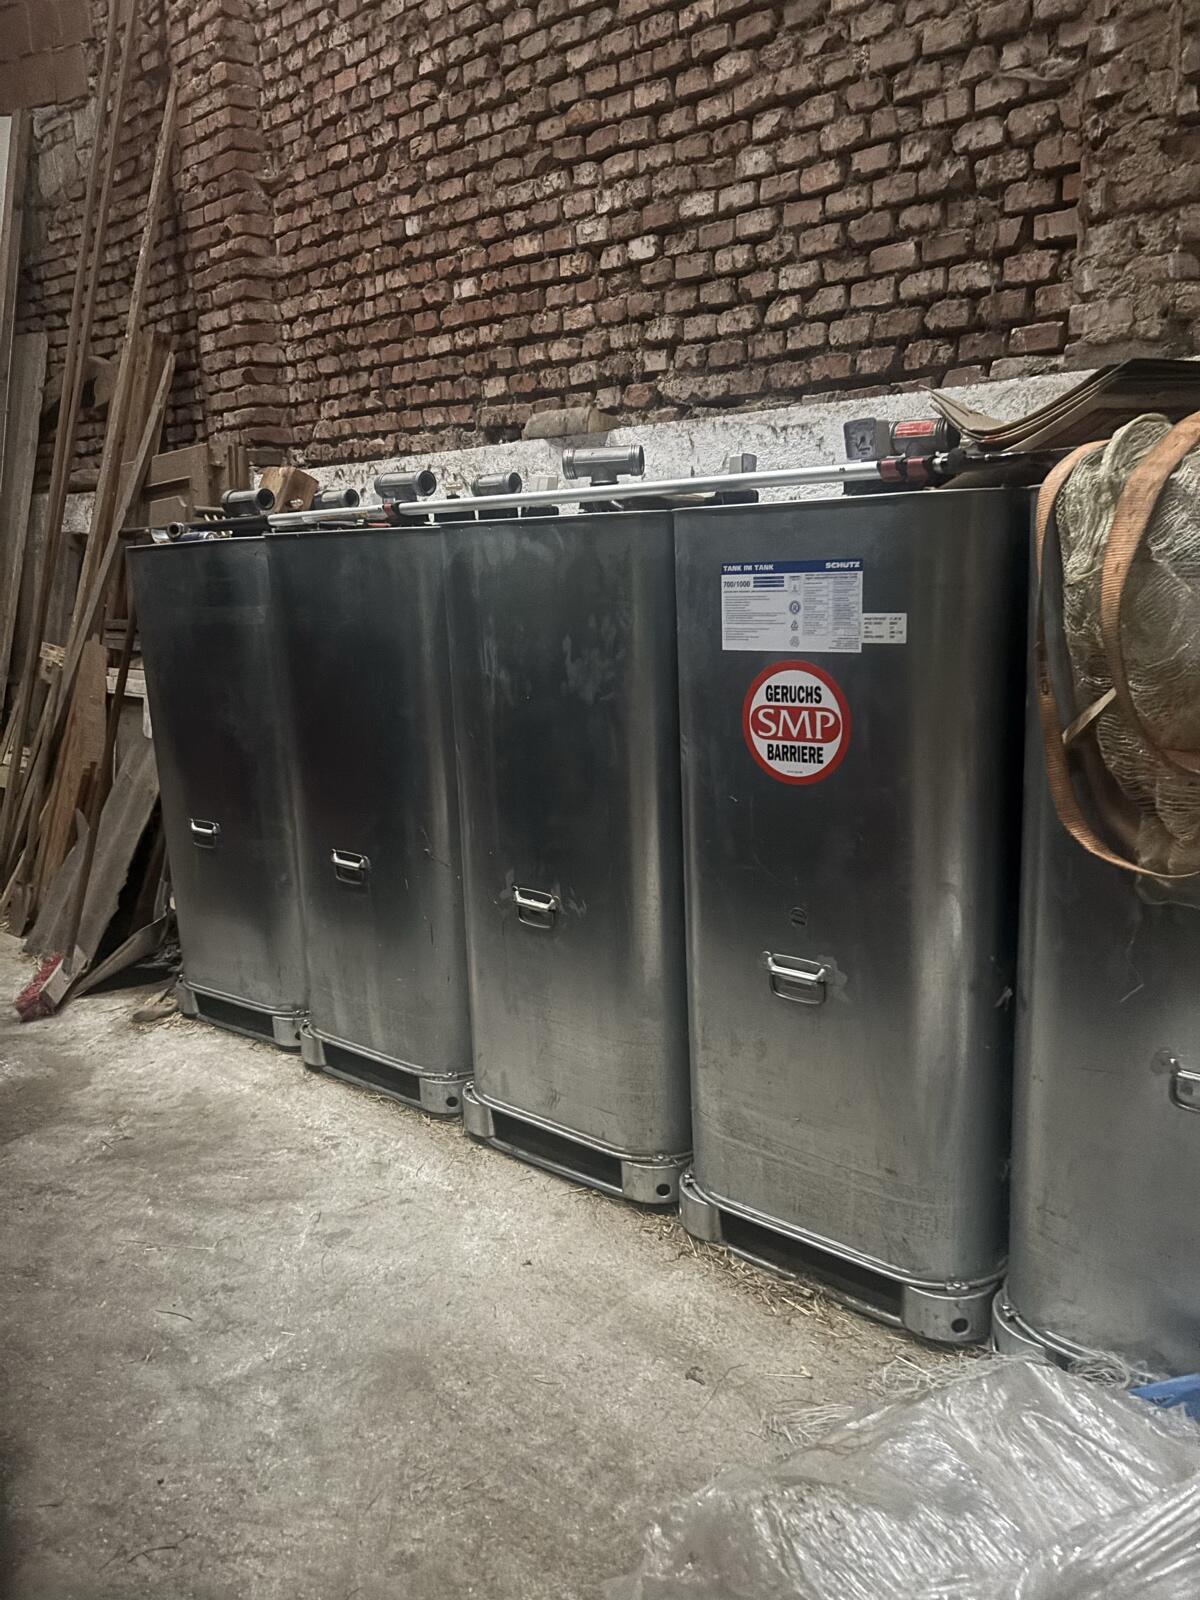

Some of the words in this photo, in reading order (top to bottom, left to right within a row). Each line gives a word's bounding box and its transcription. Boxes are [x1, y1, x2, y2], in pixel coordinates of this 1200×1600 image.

[765, 685, 822, 704] GERUCHS
[757, 709, 836, 740] SMP
[767, 743, 824, 765] BARRIERE
